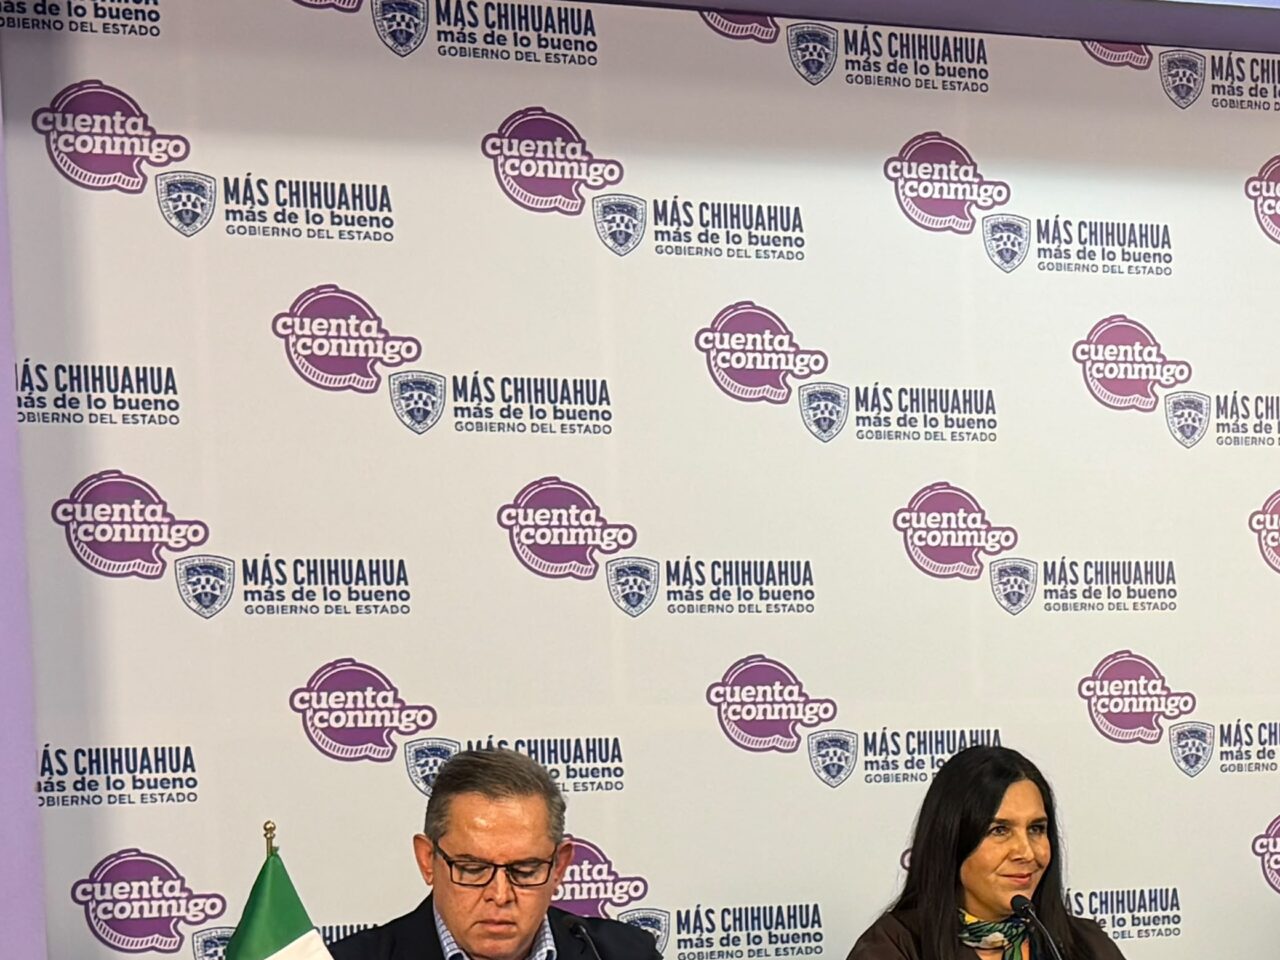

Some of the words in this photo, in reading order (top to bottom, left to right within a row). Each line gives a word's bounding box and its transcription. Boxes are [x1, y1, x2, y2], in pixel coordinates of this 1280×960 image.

[844, 26, 883, 57] MÁS
[888, 32, 987, 64] CHIHUAHUA
[844, 57, 882, 73] más
[886, 59, 909, 75] de
[913, 60, 930, 76] lo
[934, 62, 989, 80] bueno
[845, 73, 912, 88] GOBIERNO
[915, 78, 939, 90] DEL
[941, 79, 989, 93] ESTADO
[36, 112, 144, 136] cuenta
[58, 132, 187, 162] conmigo
[486, 137, 582, 160] cuenta
[505, 156, 620, 186] conmigo
[223, 172, 270, 207] MÁS
[274, 179, 393, 213] CHIHUAHUA
[224, 206, 268, 223] más
[273, 208, 299, 224] de
[304, 209, 325, 226] lo
[329, 210, 394, 229] bueno
[225, 224, 302, 238] GOBIERNO
[306, 228, 335, 240] DEL
[338, 229, 394, 242] ESTADO
[1036, 214, 1073, 246] MÁS
[1078, 220, 1172, 250] CHIHUAHUA
[1037, 245, 1071, 260] más
[1076, 246, 1097, 261] de
[1101, 247, 1116, 262] lo
[1121, 248, 1173, 264] bueno
[1037, 261, 1099, 273] GOBIERNO
[1102, 264, 1124, 274] DEL
[1127, 265, 1172, 276] ESTADO
[276, 315, 378, 338] cuenta
[296, 334, 418, 363] conmigo
[1076, 342, 1158, 362] cuenta
[1092, 358, 1189, 384] conmigo
[452, 370, 496, 404] MÁS
[500, 376, 611, 406] CHIHUAHUA
[453, 403, 494, 419] más
[499, 404, 524, 420] de
[529, 405, 547, 420] lo
[552, 405, 613, 422] bueno
[1215, 390, 1250, 421] MÁS
[454, 421, 527, 433] GOBIERNO
[530, 422, 557, 434] DEL
[560, 423, 612, 435] ESTADO
[1216, 420, 1249, 434] más
[1253, 420, 1273, 434] de
[1216, 436, 1275, 446] GOBIERNO
[56, 500, 163, 522] cuenta
[896, 509, 982, 529] cuenta
[78, 518, 205, 547] conmigo
[913, 525, 1015, 551] conmigo
[242, 555, 288, 587] MÁS
[292, 558, 409, 587] CHIHUAHUA
[665, 555, 706, 588] MÁS
[711, 560, 814, 587] CHIHUAHUA
[243, 586, 286, 602] más
[291, 586, 317, 602] de
[322, 586, 342, 602] lo
[347, 586, 411, 602] bueno
[666, 587, 704, 602] más
[709, 587, 732, 601] de
[737, 587, 754, 601] lo
[758, 587, 815, 601] bueno
[244, 604, 320, 615] GOBIERNO
[324, 604, 351, 615] DEL
[355, 604, 411, 615] ESTADO
[667, 604, 735, 614] GOBIERNO
[738, 603, 762, 614] DEL
[765, 603, 815, 613] ESTADO
[293, 687, 394, 709] cuenta
[710, 681, 799, 703] cuenta
[314, 704, 434, 731] conmigo
[728, 697, 834, 724] conmigo
[1219, 718, 1254, 748] MÁS
[1219, 747, 1252, 761] más
[1256, 746, 1276, 760] de
[1219, 762, 1278, 773] GOBIERNO
[76, 876, 181, 901] cuenta
[97, 893, 223, 921] conmigo
[676, 903, 716, 935] MÁS
[720, 903, 822, 934] CHIHUAHUA
[676, 934, 714, 950] más
[718, 933, 742, 948] de
[746, 932, 763, 946] lo
[767, 931, 824, 945] bueno
[747, 948, 772, 959] DEL
[774, 945, 823, 957] ESTADO
